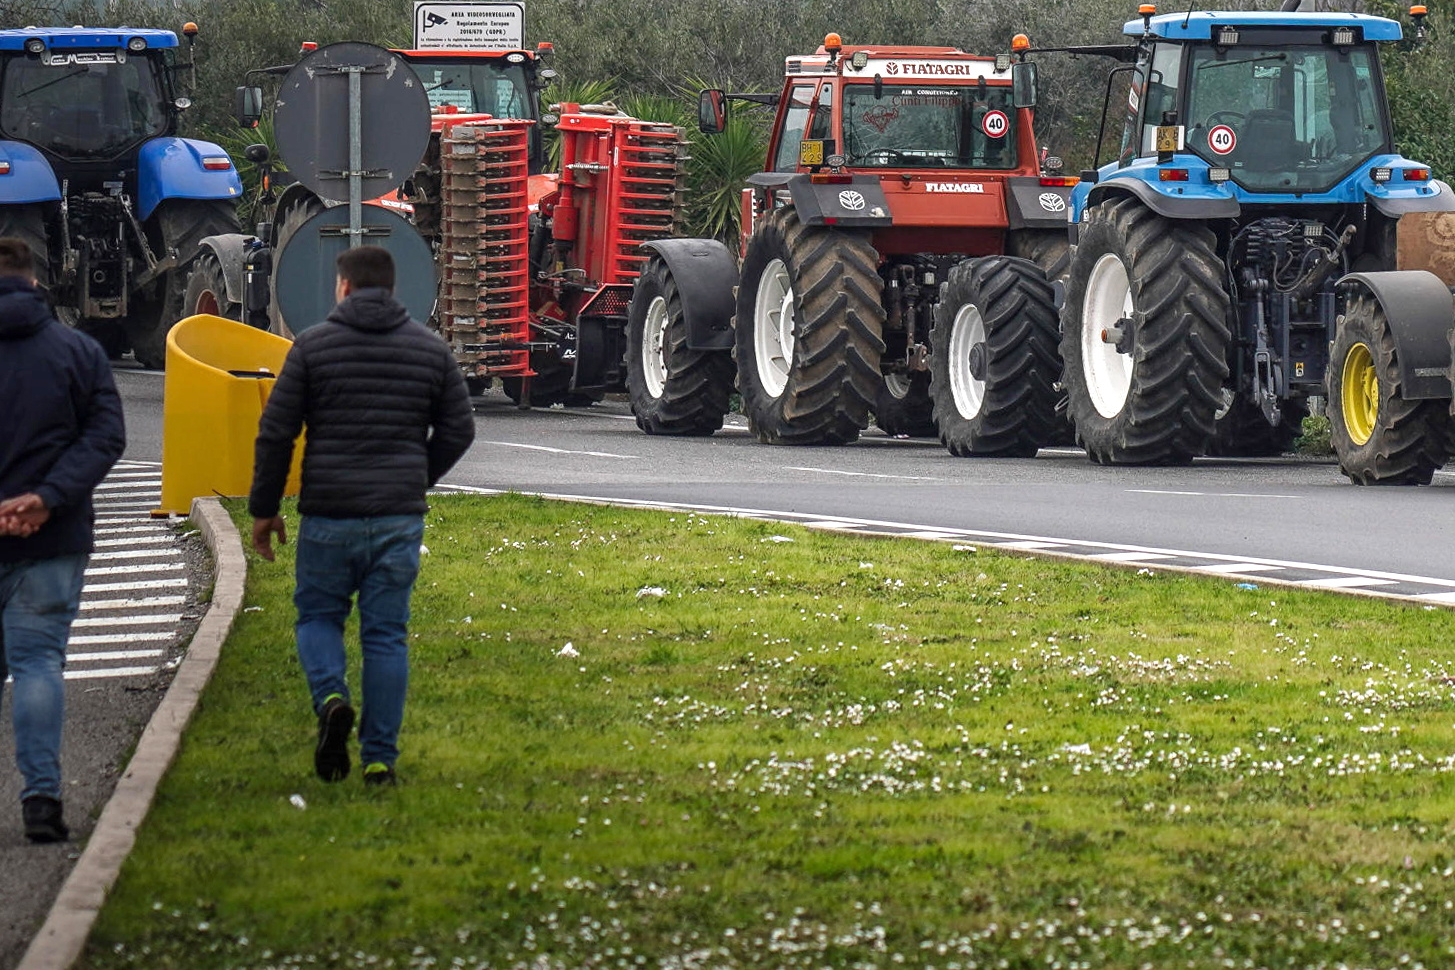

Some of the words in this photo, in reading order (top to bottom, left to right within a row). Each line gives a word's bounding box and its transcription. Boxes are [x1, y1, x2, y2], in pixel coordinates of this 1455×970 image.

[485, 28, 507, 36] (GDPR)
[902, 63, 971, 75] FIATAGRI
[988, 118, 1003, 130] 40
[1215, 133, 1230, 145] 40
[925, 182, 984, 193] FIATAGRI
